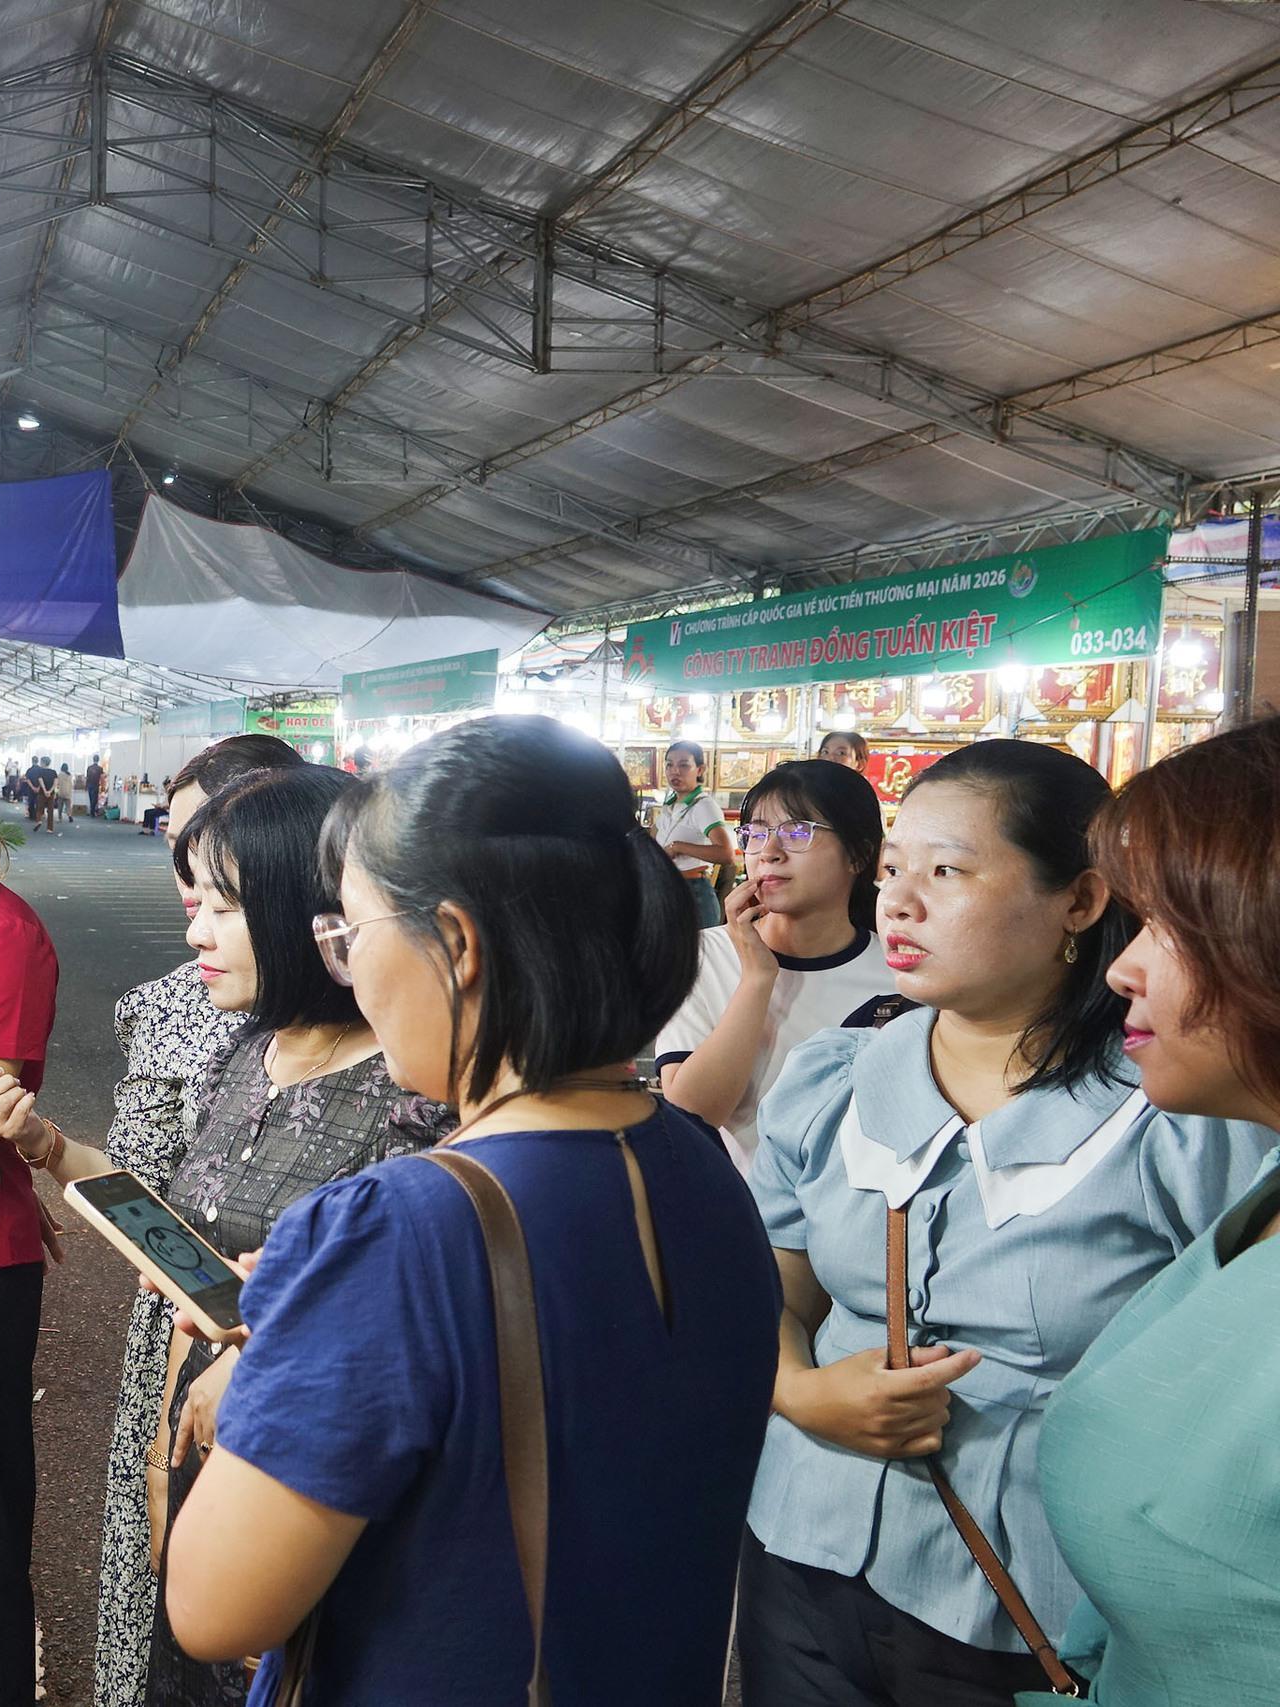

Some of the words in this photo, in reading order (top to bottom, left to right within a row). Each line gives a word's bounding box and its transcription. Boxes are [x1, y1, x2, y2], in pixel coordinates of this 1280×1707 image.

[786, 604, 803, 618] GIA
[818, 593, 838, 613] XÚC
[865, 584, 913, 607] THƯƠNG
[915, 582, 939, 601] MẠI
[941, 573, 971, 594] NĂM
[973, 569, 1006, 589] 2026
[684, 648, 725, 680] CÔNG
[726, 645, 748, 675] TY
[749, 638, 806, 673] TRANH
[873, 612, 936, 660] TUẤN
[940, 609, 997, 659] KIỆT
[1070, 625, 1147, 657] 033-034
